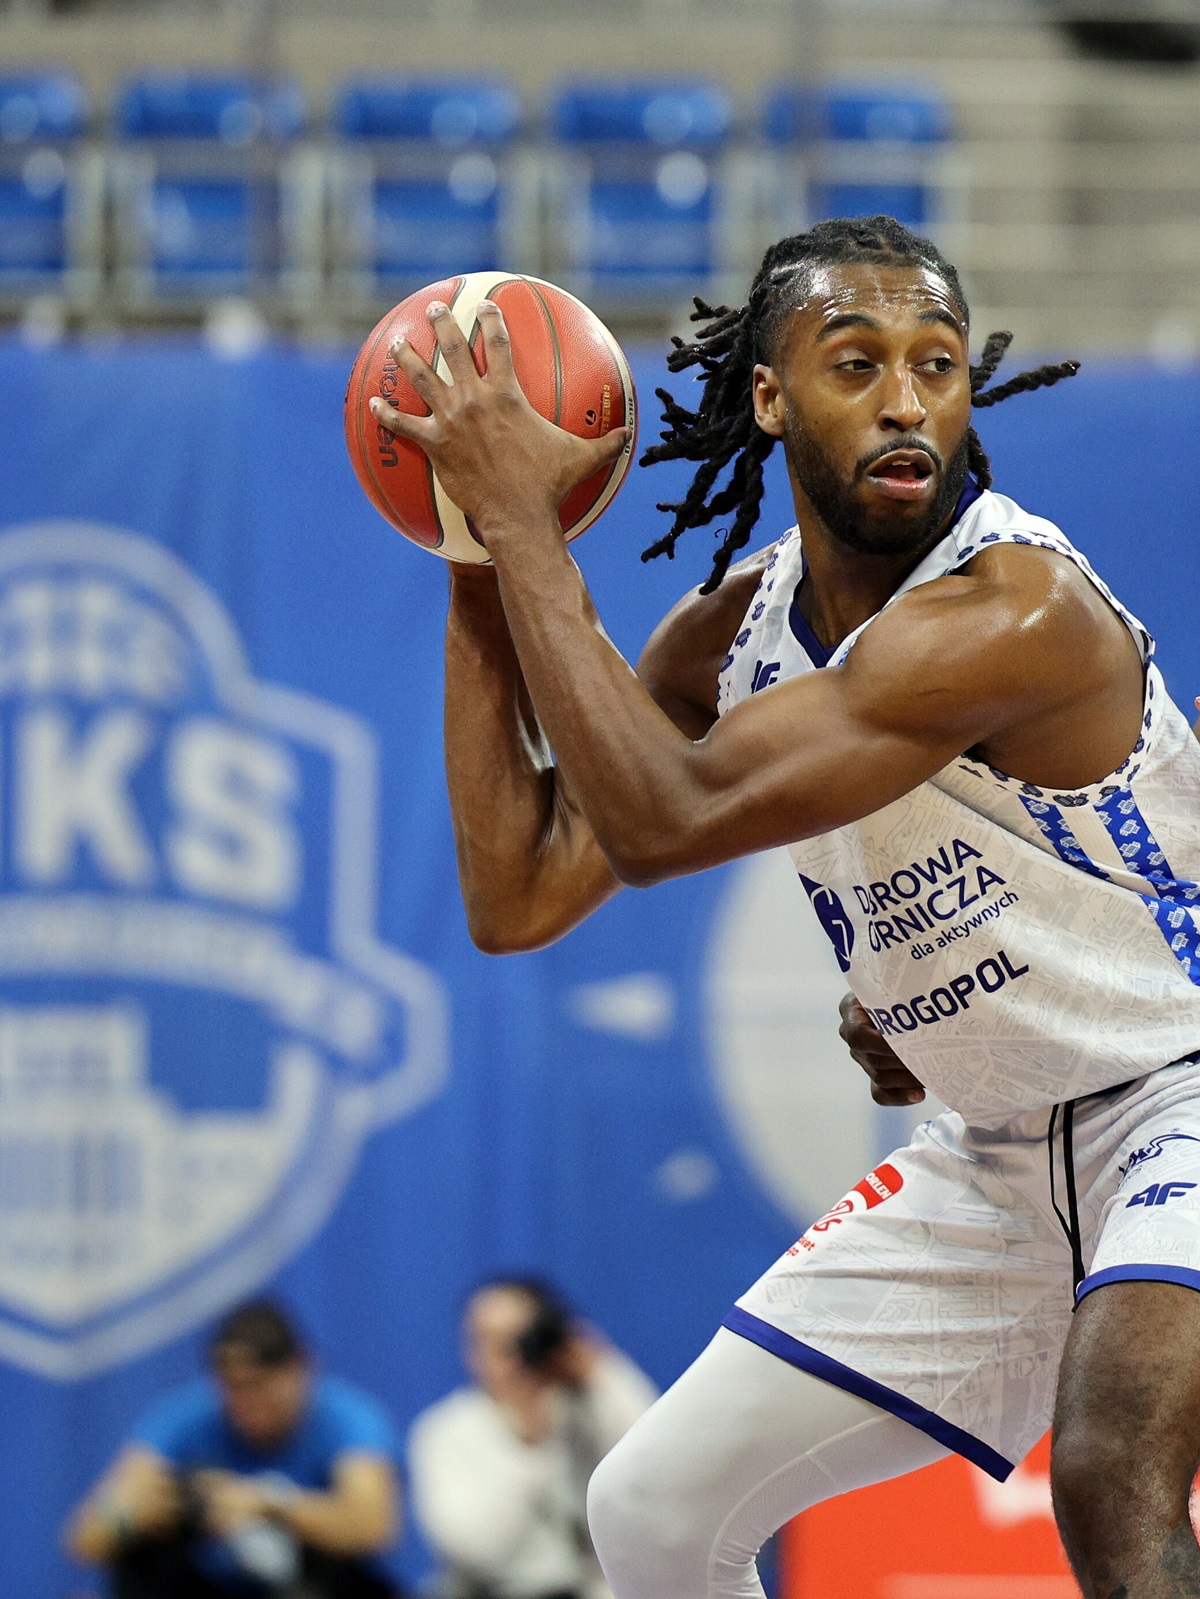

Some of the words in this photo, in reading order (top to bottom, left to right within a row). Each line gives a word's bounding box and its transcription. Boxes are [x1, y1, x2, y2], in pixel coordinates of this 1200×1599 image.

[910, 943, 936, 961] dla
[937, 890, 1020, 949] aktywnych
[865, 1171, 893, 1200] ORLEN
[1125, 1182, 1198, 1208] 4F
